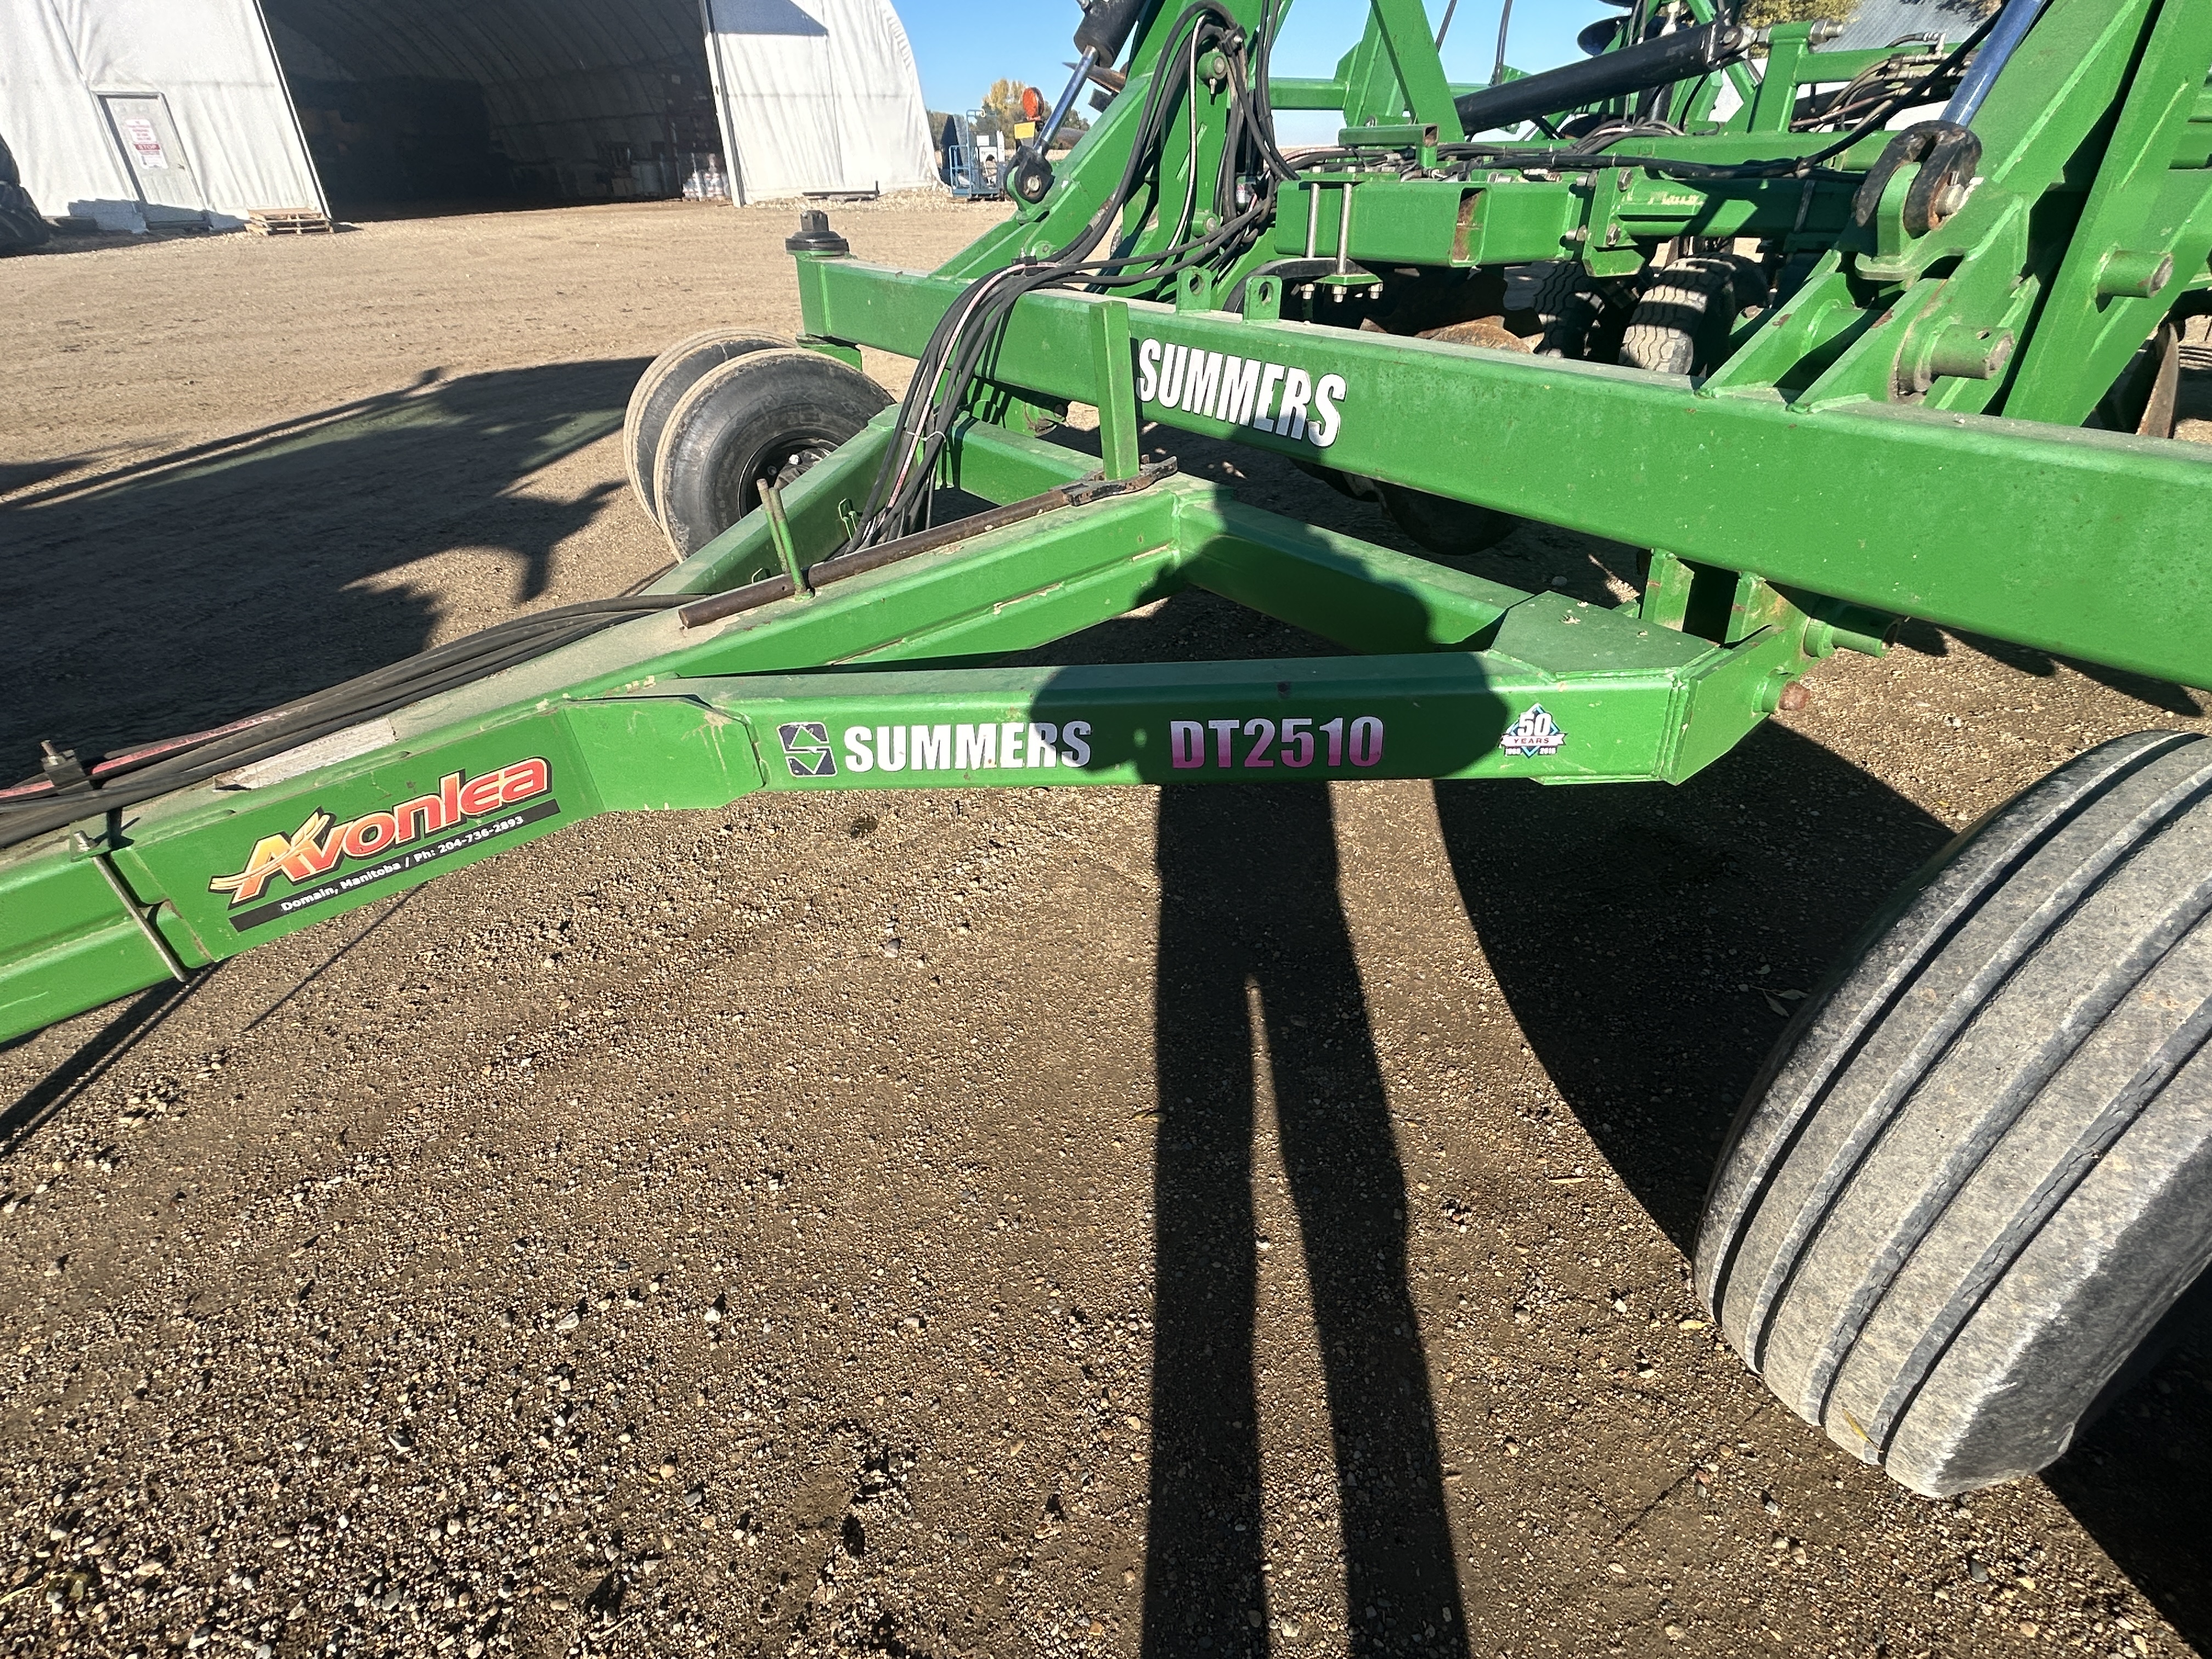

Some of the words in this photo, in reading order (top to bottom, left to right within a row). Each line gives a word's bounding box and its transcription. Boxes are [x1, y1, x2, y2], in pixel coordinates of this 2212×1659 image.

[1136, 338, 1347, 448] SUMMERS
[843, 720, 1092, 773] SUMMERS
[1169, 715, 1385, 769] DT2510
[1517, 713, 1552, 736] 50
[210, 757, 550, 906] Avonlea
[280, 885, 339, 911] Domain,
[338, 861, 402, 889] Manitoba
[404, 856, 410, 868] /
[413, 849, 436, 863] Ph:
[437, 815, 524, 854] 204-736-2893
